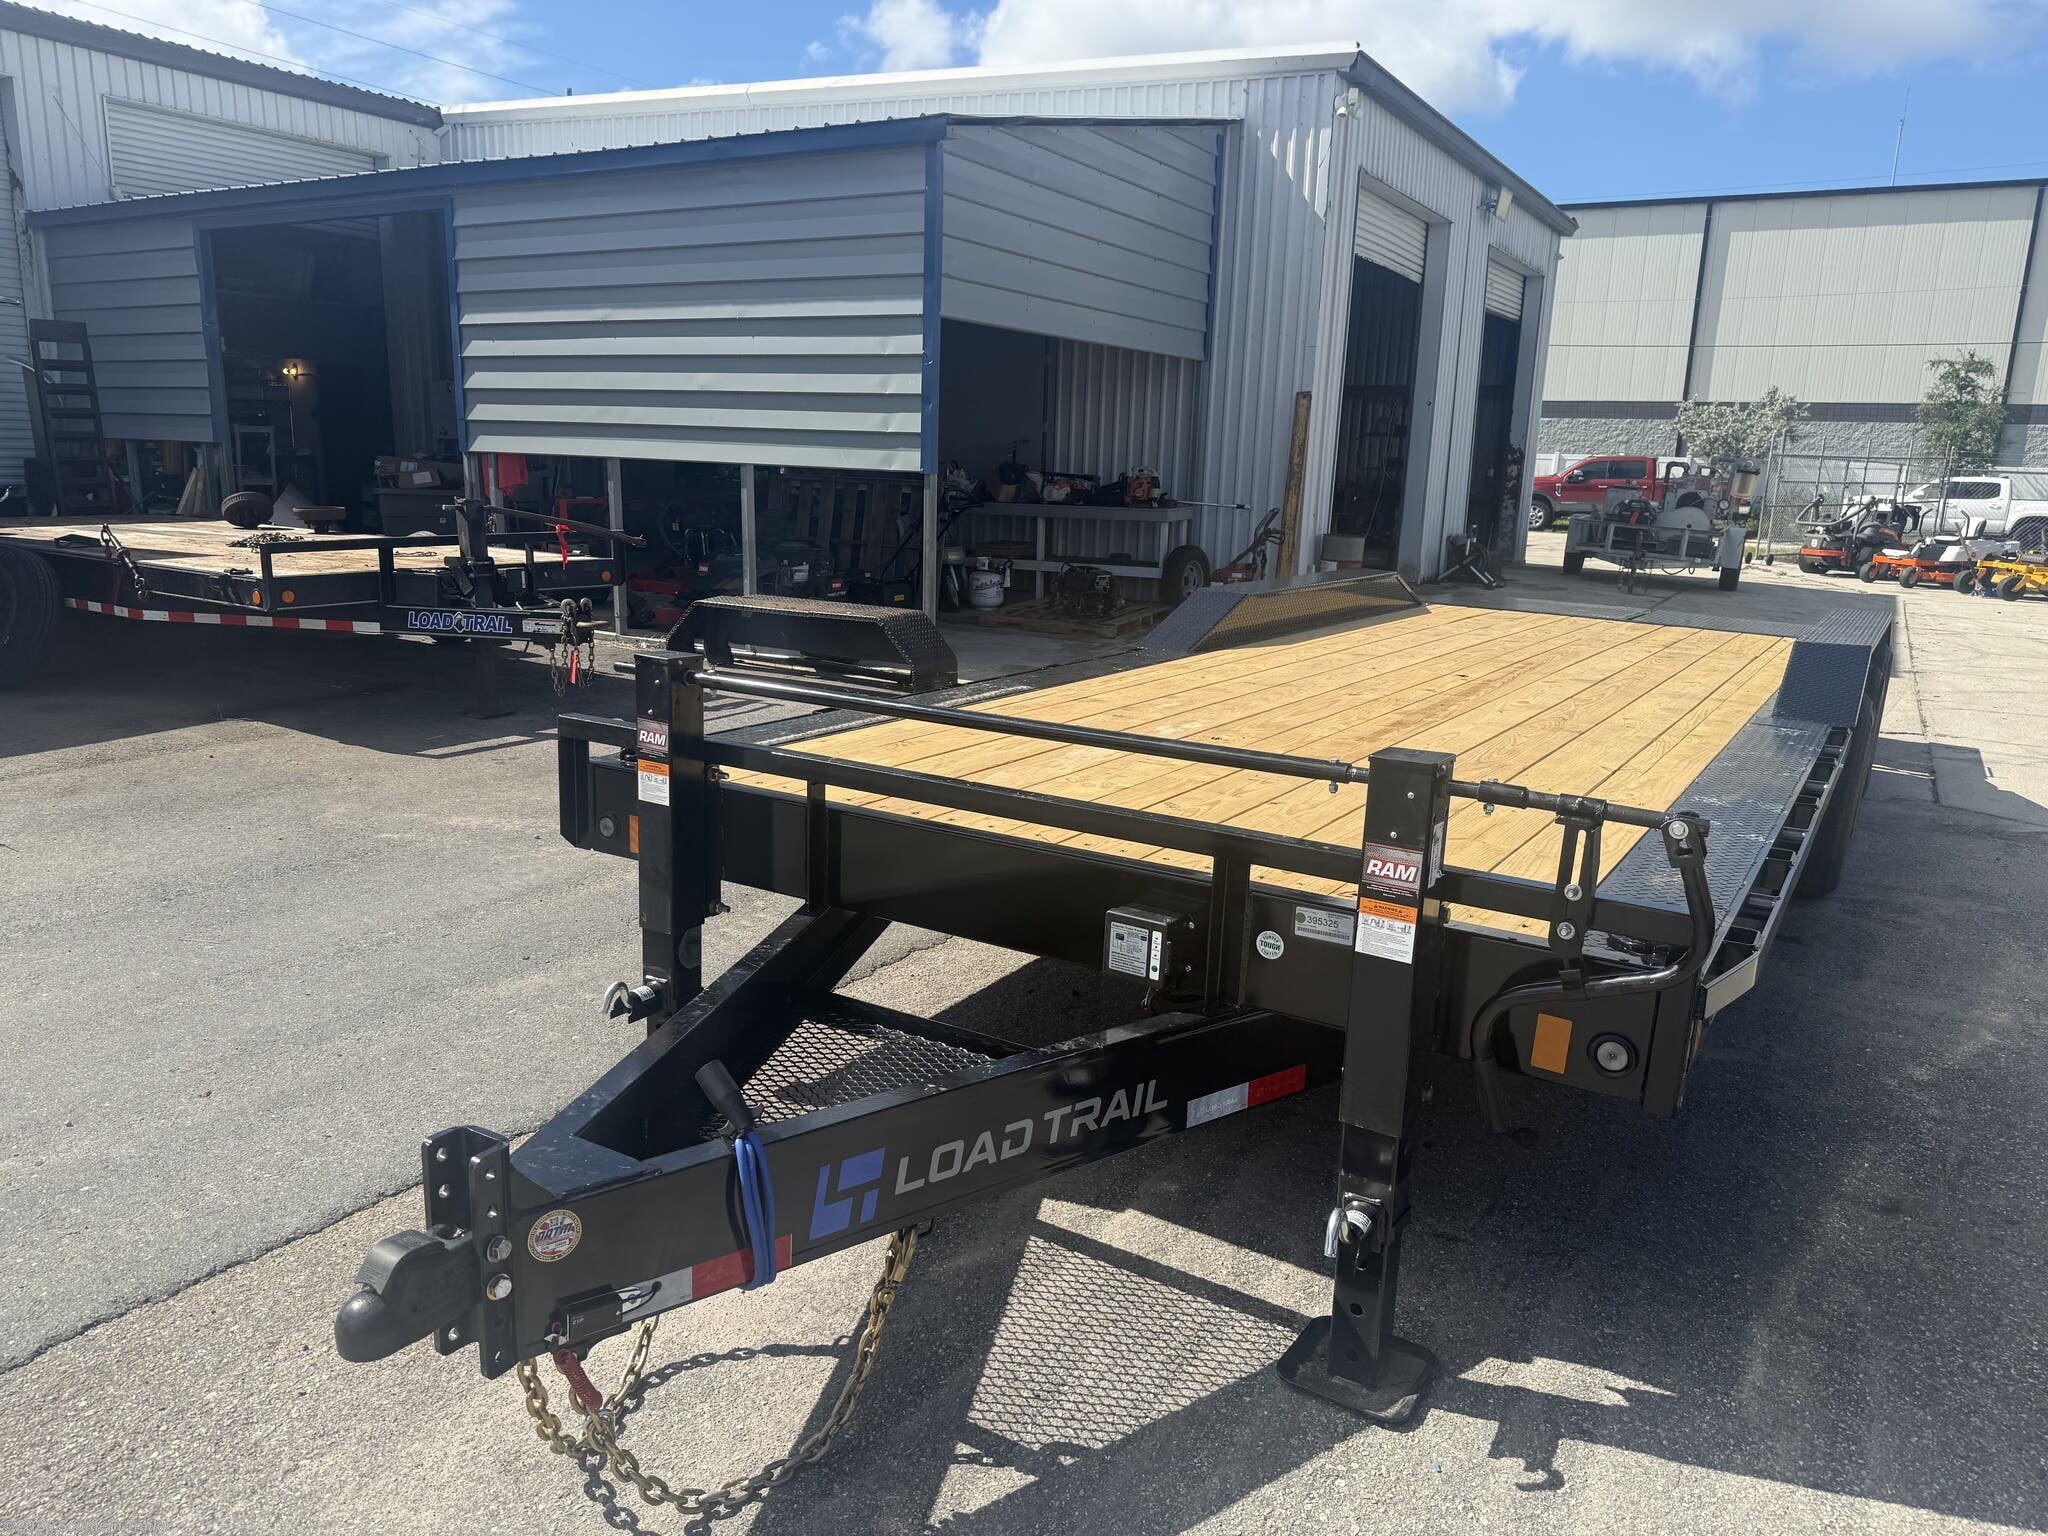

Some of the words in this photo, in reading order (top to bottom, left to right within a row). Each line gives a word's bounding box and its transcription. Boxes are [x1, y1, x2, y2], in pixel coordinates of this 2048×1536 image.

[407, 610, 454, 630] LOAD
[462, 613, 513, 634] TRAIL
[639, 729, 667, 747] RAM
[1366, 859, 1418, 882] RAM
[895, 1118, 1034, 1196] LOAD
[1043, 1079, 1169, 1145] TRAIL
